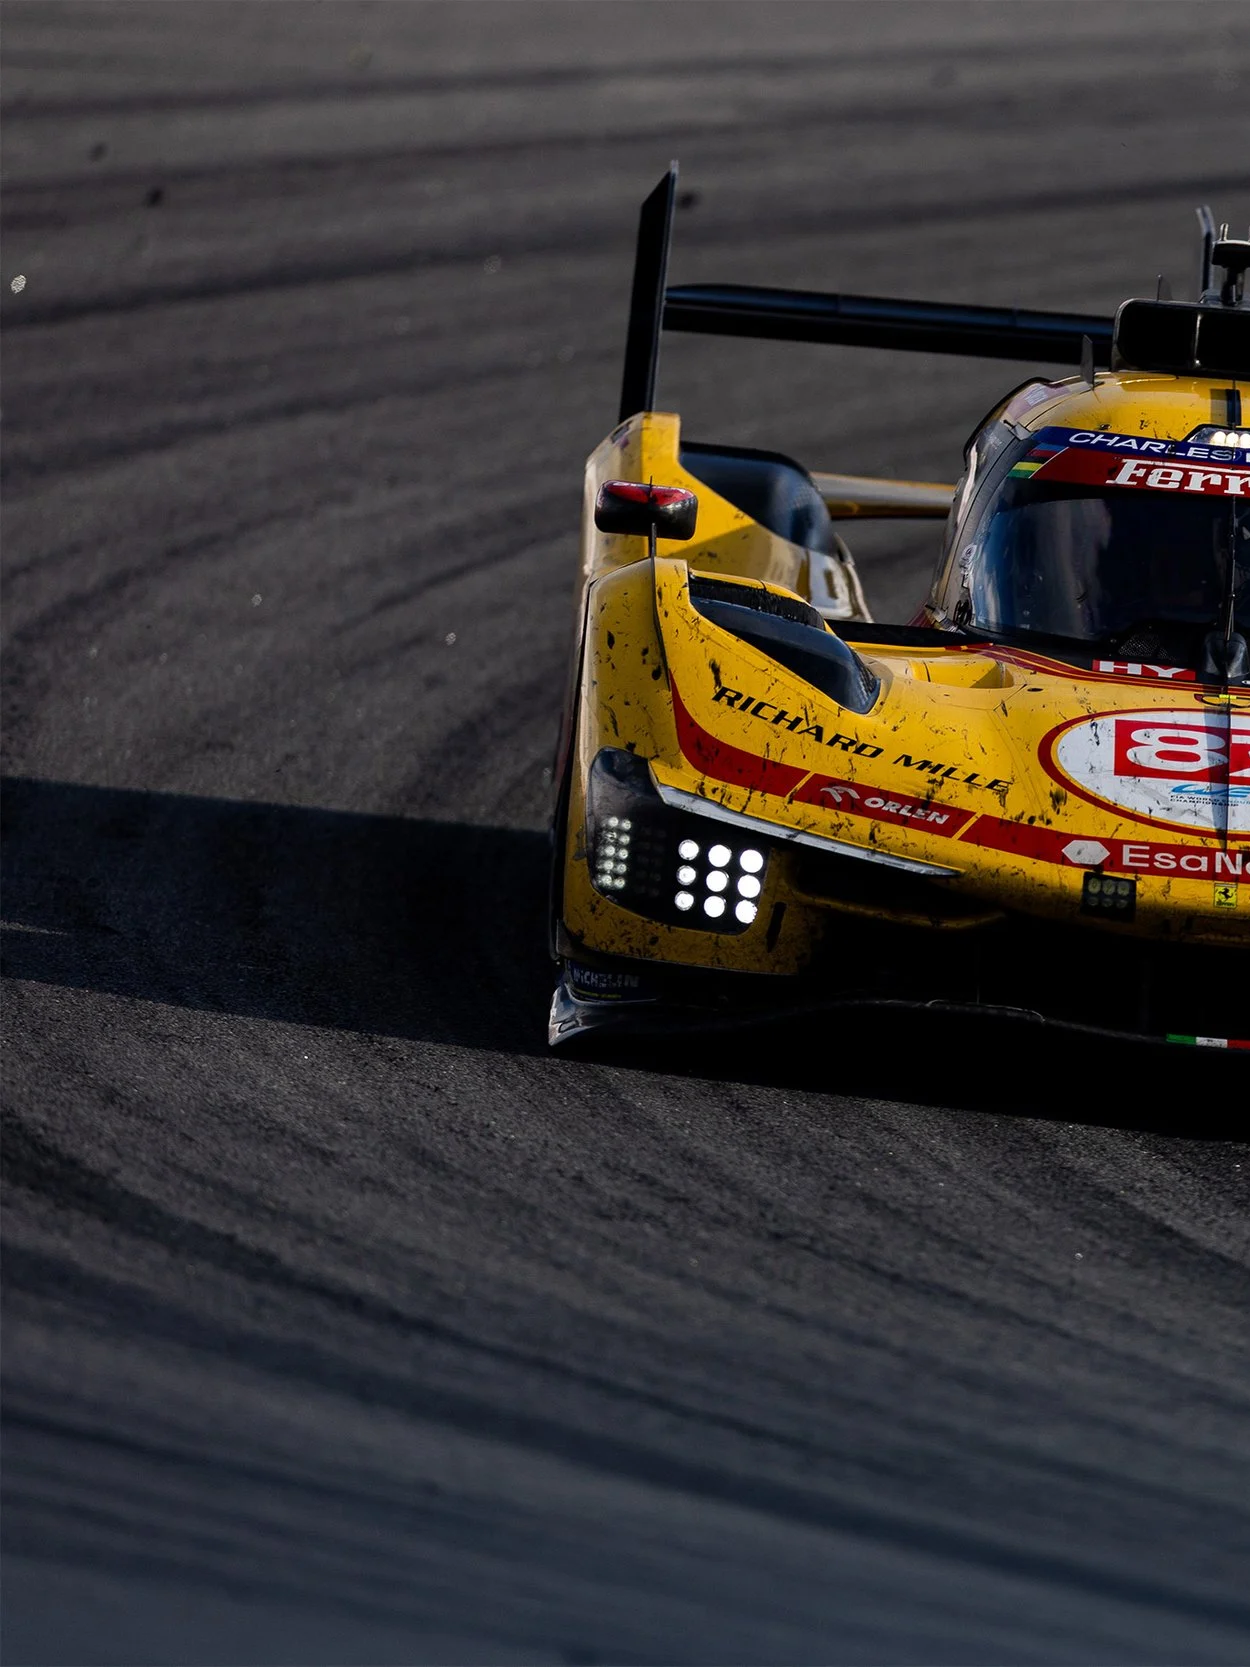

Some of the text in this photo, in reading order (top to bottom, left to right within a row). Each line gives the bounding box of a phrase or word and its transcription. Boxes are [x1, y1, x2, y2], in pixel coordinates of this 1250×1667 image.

[1068, 432, 1233, 461] CHARLES
[1100, 660, 1188, 678] HY
[712, 686, 1014, 792] RICHARD MILLE
[864, 797, 950, 825] ORLEN
